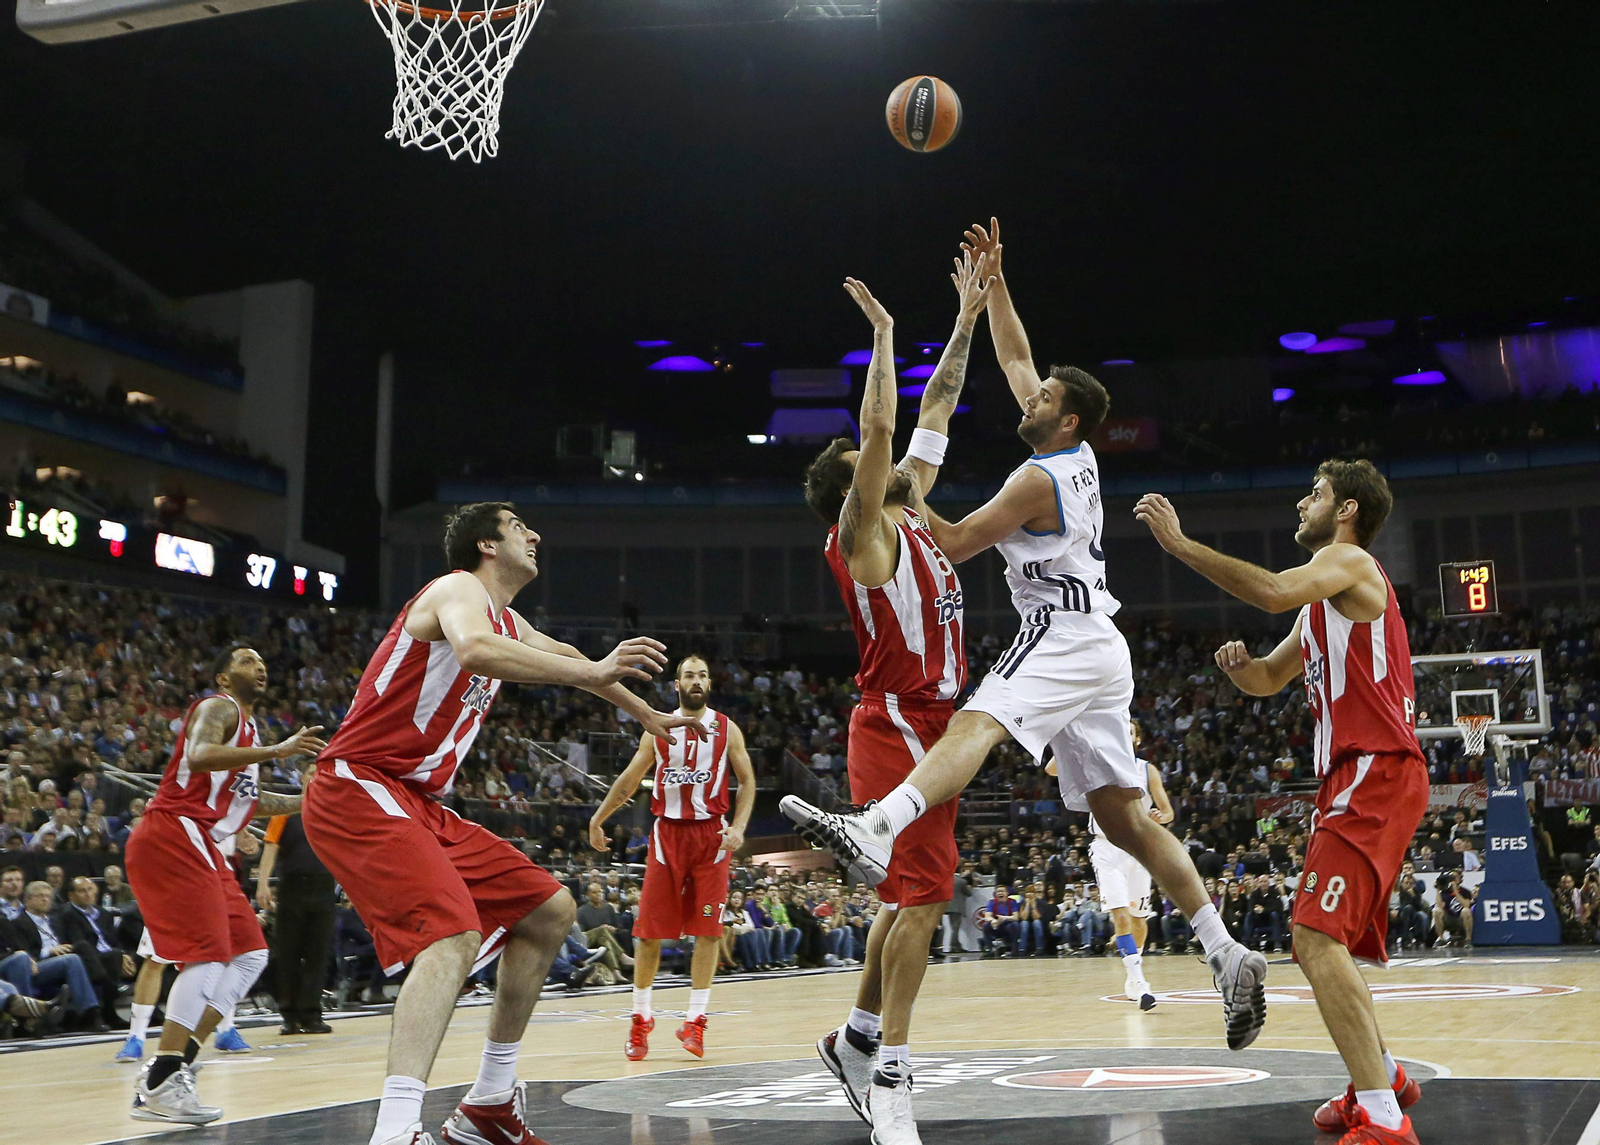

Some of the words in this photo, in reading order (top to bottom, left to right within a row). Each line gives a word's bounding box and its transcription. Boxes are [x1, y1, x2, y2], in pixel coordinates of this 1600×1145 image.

[1109, 425, 1139, 443] sky
[6, 500, 77, 548] 1:43
[246, 552, 277, 589] 37
[1460, 566, 1489, 584] 1:43
[1469, 583, 1486, 611] 8
[686, 740, 696, 760] 7
[1490, 836, 1528, 850] EFES
[1320, 875, 1346, 913] 8
[1483, 899, 1546, 922] EFES
